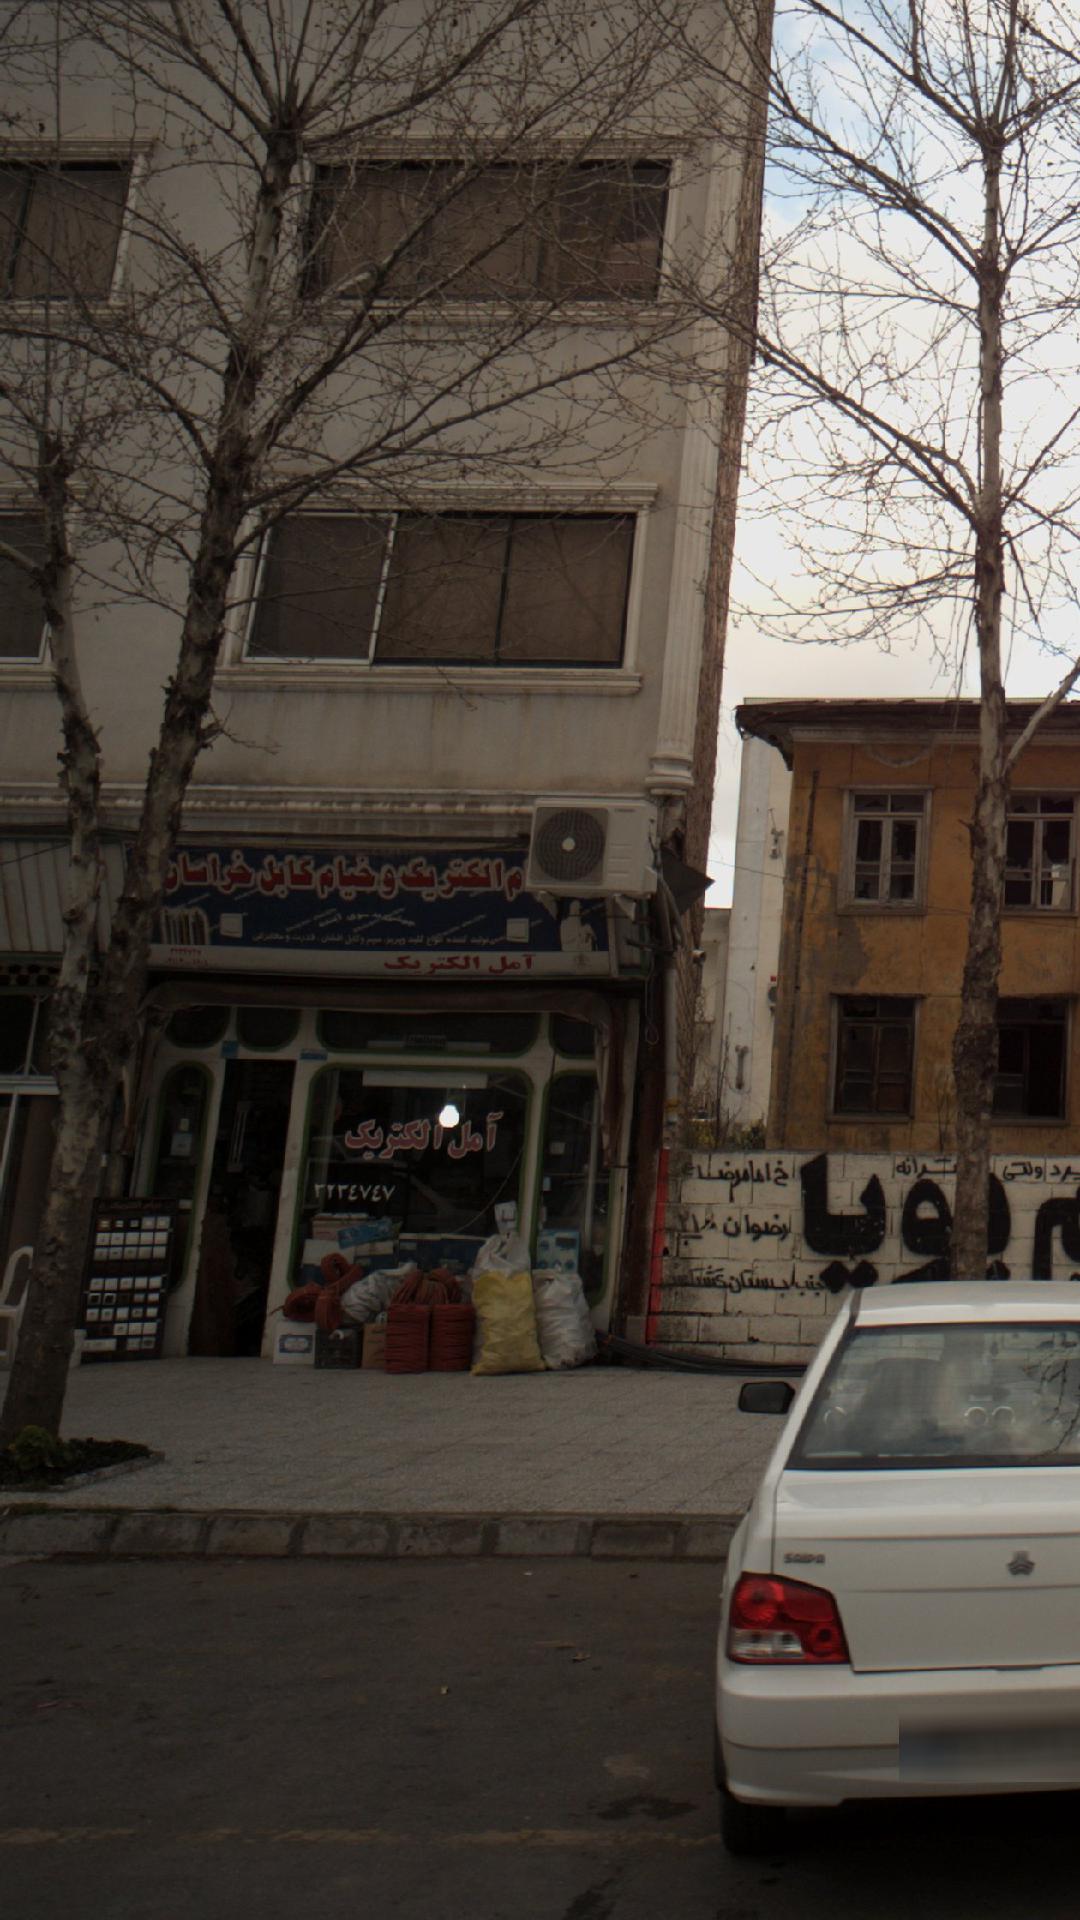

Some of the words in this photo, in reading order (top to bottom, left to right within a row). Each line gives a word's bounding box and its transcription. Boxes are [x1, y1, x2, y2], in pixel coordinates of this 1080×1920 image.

[257, 852, 315, 898] کابل
[378, 863, 399, 902] و
[400, 856, 504, 902] الکتریک
[384, 955, 481, 975] الکتریک
[488, 953, 536, 974] آمل
[344, 1119, 445, 1160] الکتریک
[447, 1111, 504, 1159] آمل
